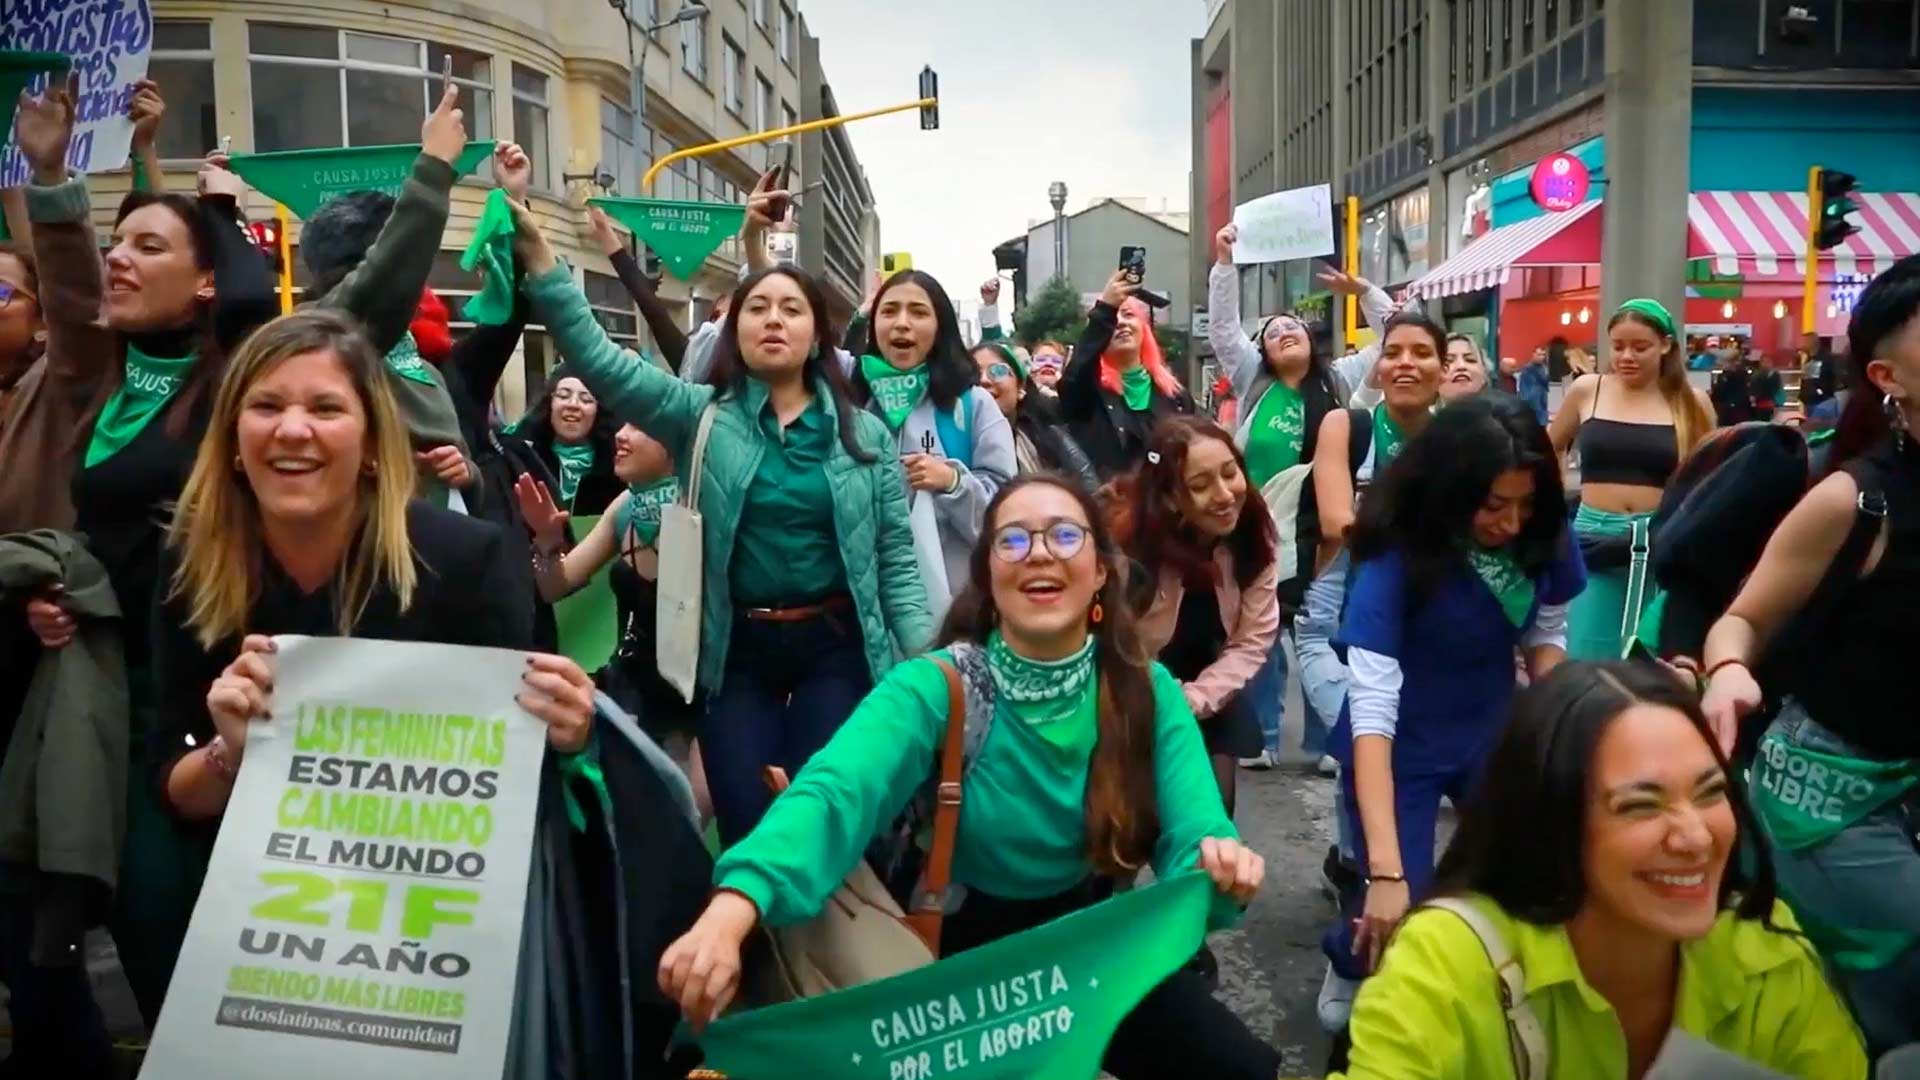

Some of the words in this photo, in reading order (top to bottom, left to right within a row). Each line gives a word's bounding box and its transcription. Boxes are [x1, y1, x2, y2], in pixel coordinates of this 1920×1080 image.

[312, 168, 360, 186] CAUSA
[363, 164, 408, 182] JUSTA
[648, 207, 679, 218] CAUSA
[681, 209, 711, 222] JUSTA
[294, 702, 347, 754] LAS
[348, 706, 506, 768] FEMINISTAS
[287, 754, 500, 801] ESTAMOS
[1760, 738, 1876, 801] ABORTO
[1761, 763, 1846, 823] LIBRE
[277, 785, 494, 848] CAMBIANDO
[266, 831, 318, 863] EL
[328, 839, 487, 879] MUNDO
[238, 927, 327, 963] UN
[336, 940, 472, 979] AÑO
[226, 964, 322, 1001] SIENDO
[381, 980, 467, 1021] LIBRES
[870, 992, 967, 1049] CAUSA
[976, 964, 1069, 1020] JUSTA
[222, 1002, 458, 1047] @doslatinas.comunidad
[889, 1049, 933, 1080] POR
[942, 1037, 970, 1072] EL
[978, 1004, 1075, 1063] ABORTO
